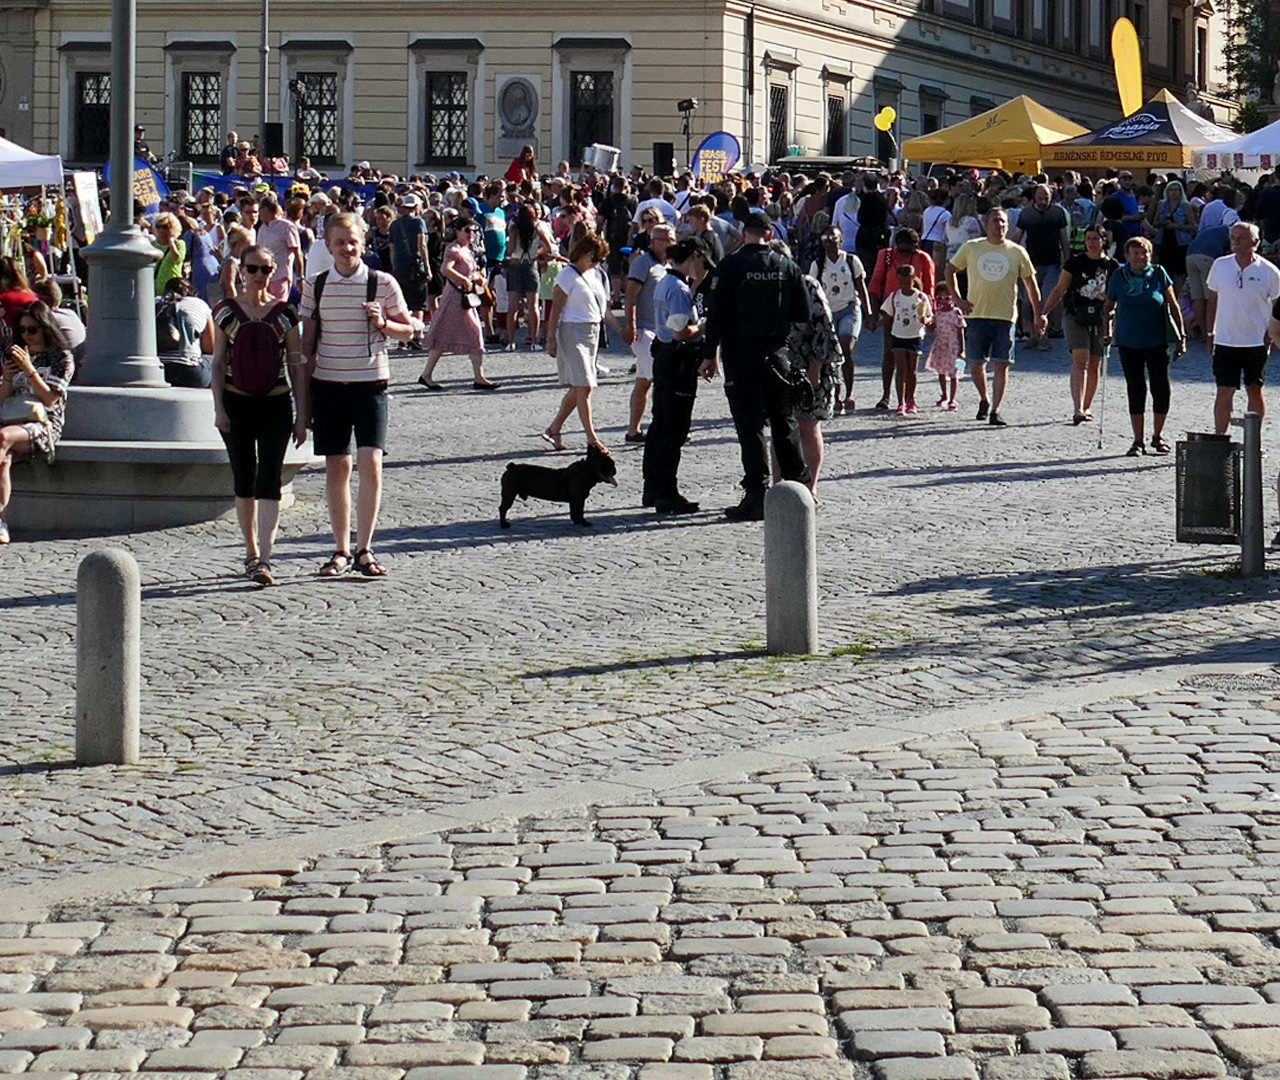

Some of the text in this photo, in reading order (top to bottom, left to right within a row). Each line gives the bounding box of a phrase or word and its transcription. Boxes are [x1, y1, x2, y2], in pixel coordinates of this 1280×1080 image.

[699, 149, 727, 159] BRASIL
[1147, 151, 1168, 162] PIVO
[699, 160, 727, 174] FEST
[699, 172, 723, 184] BRN
